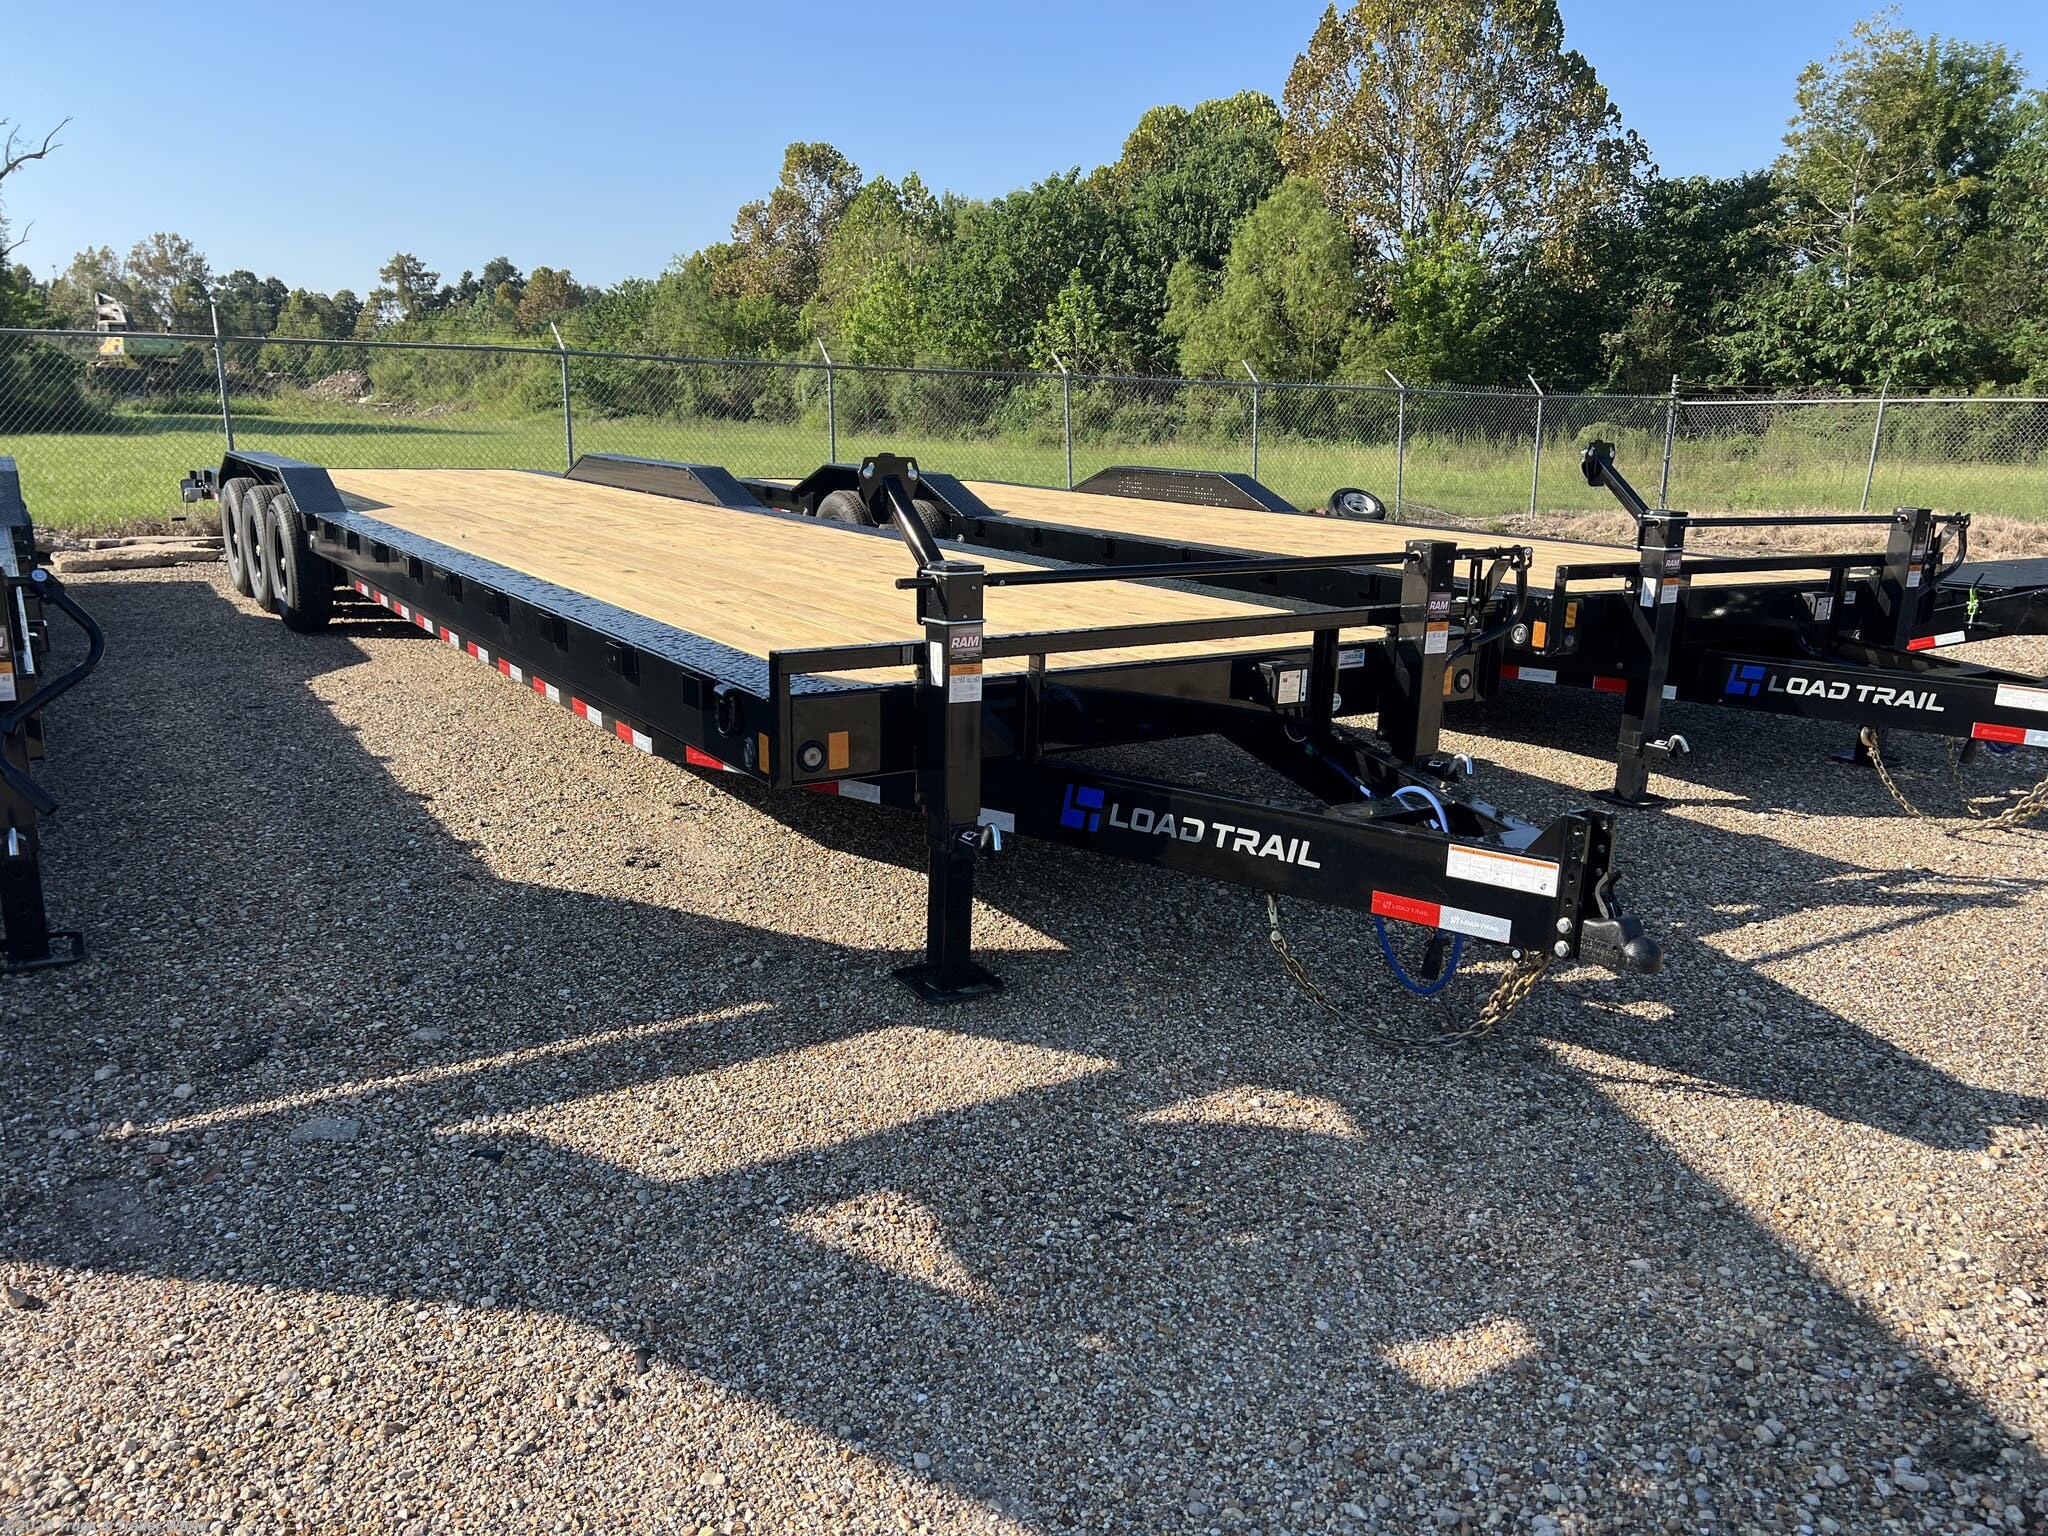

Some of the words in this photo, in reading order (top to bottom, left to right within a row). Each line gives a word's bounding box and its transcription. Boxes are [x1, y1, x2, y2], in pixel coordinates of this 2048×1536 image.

[1429, 600, 1448, 610] RAM
[951, 635, 980, 649] RAM
[1767, 675, 1851, 700] LOAD
[1855, 684, 1945, 712] TRAIL
[1108, 803, 1206, 843] LOAD
[1212, 822, 1321, 869] TRAIL
[1391, 903, 1410, 912] LOAD
[1410, 907, 1430, 917] TRAIL
